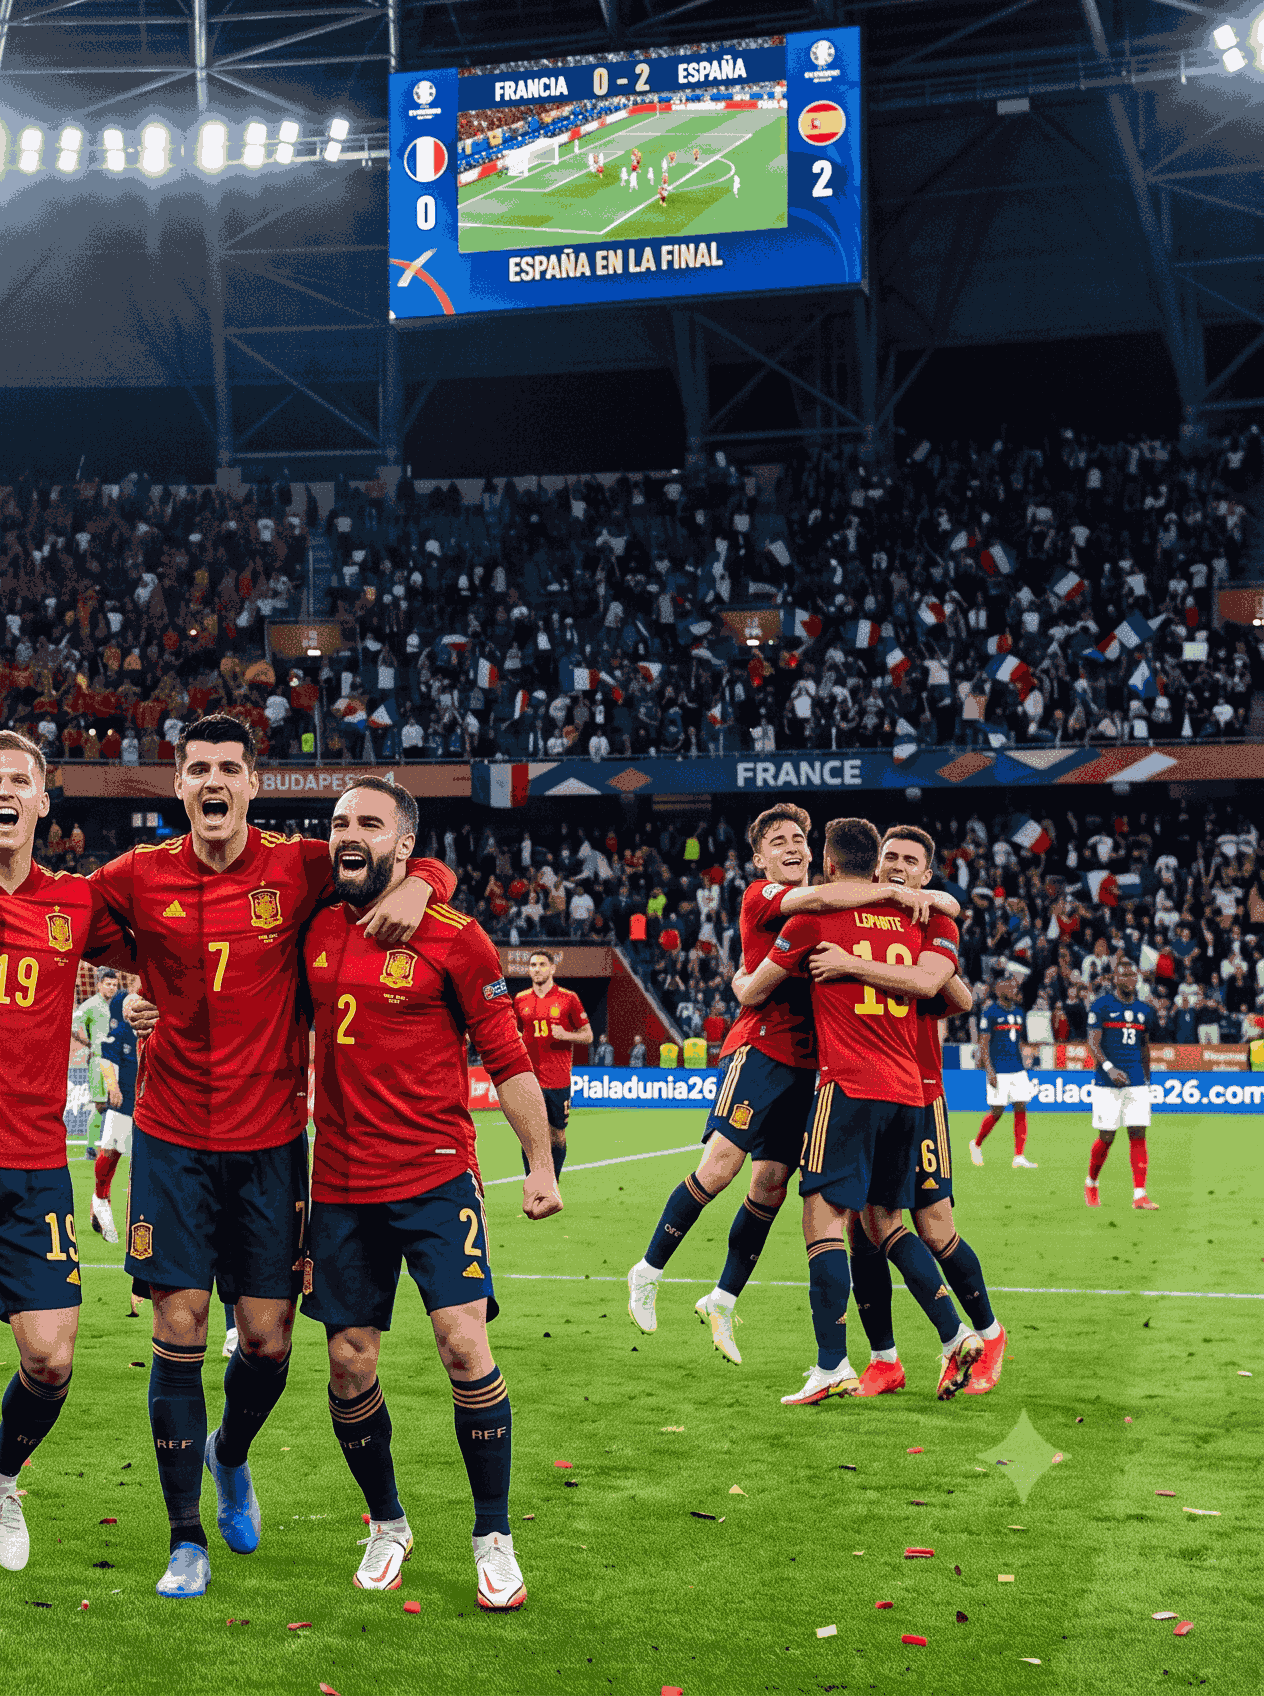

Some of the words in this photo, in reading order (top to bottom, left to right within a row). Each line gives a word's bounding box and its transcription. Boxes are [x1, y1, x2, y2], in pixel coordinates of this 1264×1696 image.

[494, 75, 568, 102] FRANCIA
[592, 67, 609, 96] 0
[634, 63, 650, 92] 2
[678, 54, 747, 85] ESPAÑA
[811, 159, 833, 198] 2
[416, 194, 436, 231] 0
[508, 247, 592, 283] ESPAÑA
[595, 250, 624, 275] EN
[628, 246, 657, 274] LA
[660, 241, 724, 271] FINAL
[263, 773, 360, 791] BUDAPES
[736, 759, 862, 788] FRANCE
[207, 941, 230, 992] 7
[336, 993, 358, 1045] 2
[915, 1139, 937, 1173] 6
[459, 1206, 482, 1257] 2
[156, 1438, 194, 1450] REF
[472, 1426, 507, 1440] REF
